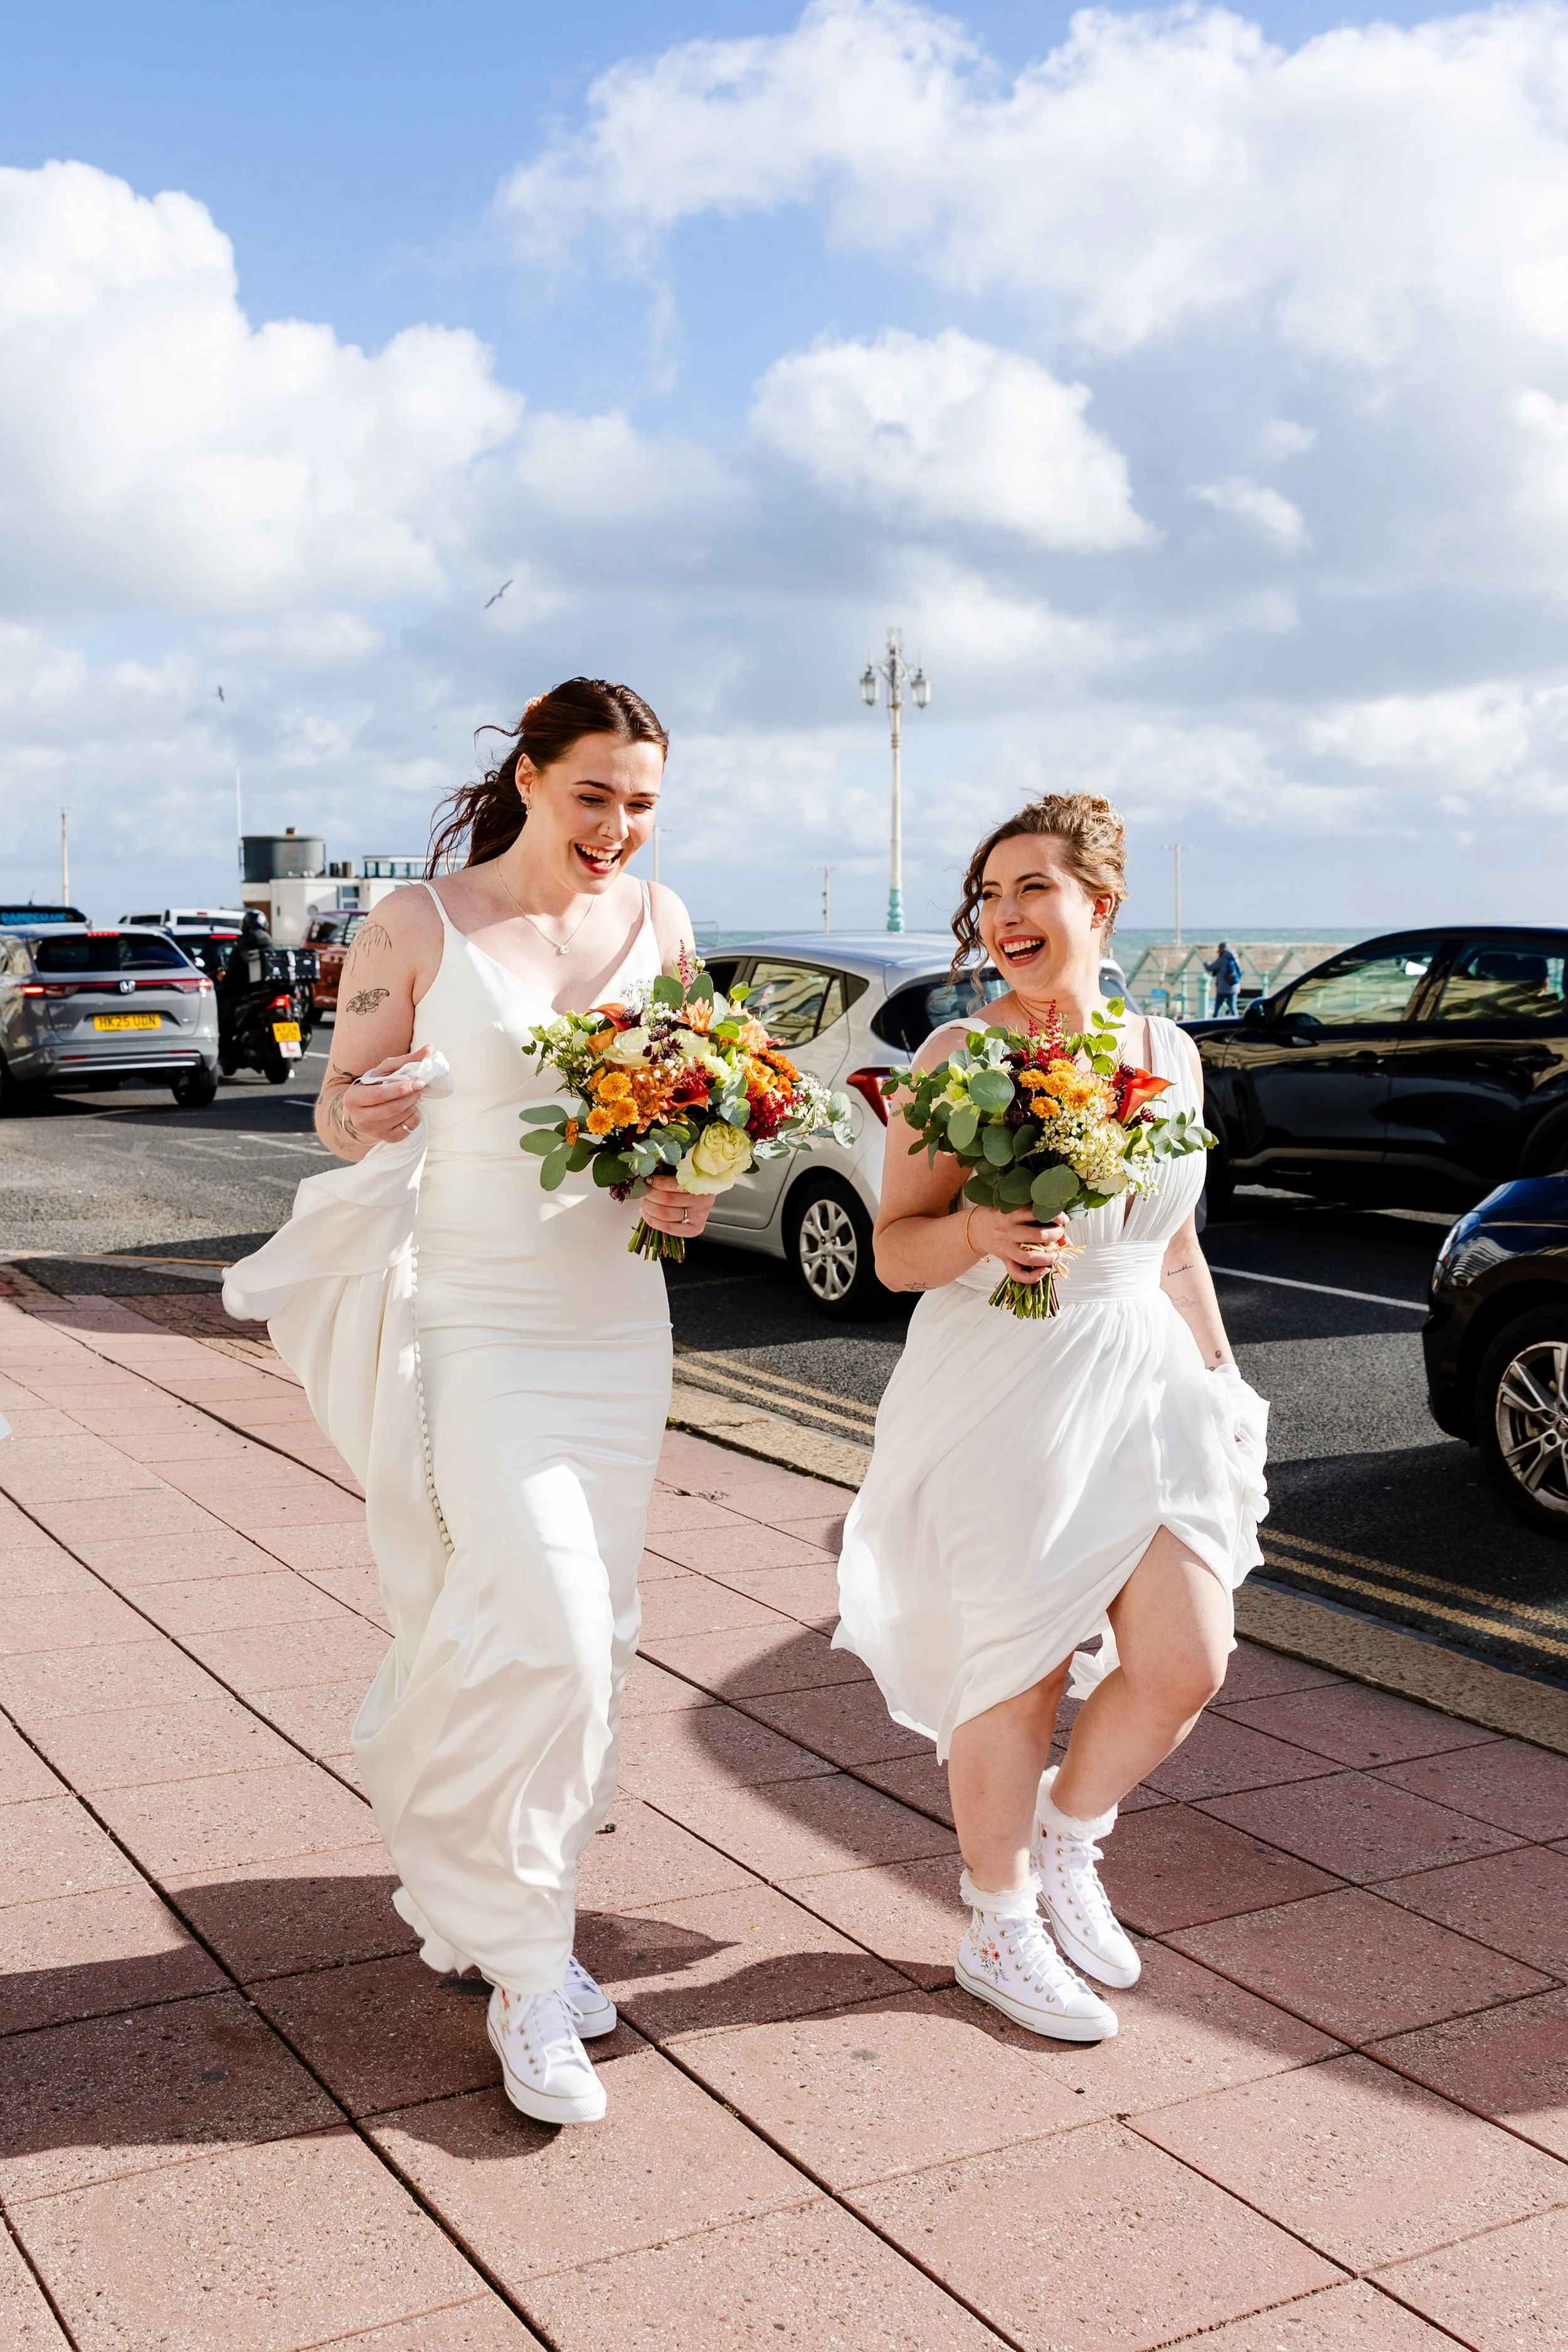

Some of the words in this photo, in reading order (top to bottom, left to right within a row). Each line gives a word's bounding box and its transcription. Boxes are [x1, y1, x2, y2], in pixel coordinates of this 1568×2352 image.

[99, 1015, 130, 1027] HK25
[134, 1014, 156, 1026] UDN
[285, 1041, 295, 1052] L
